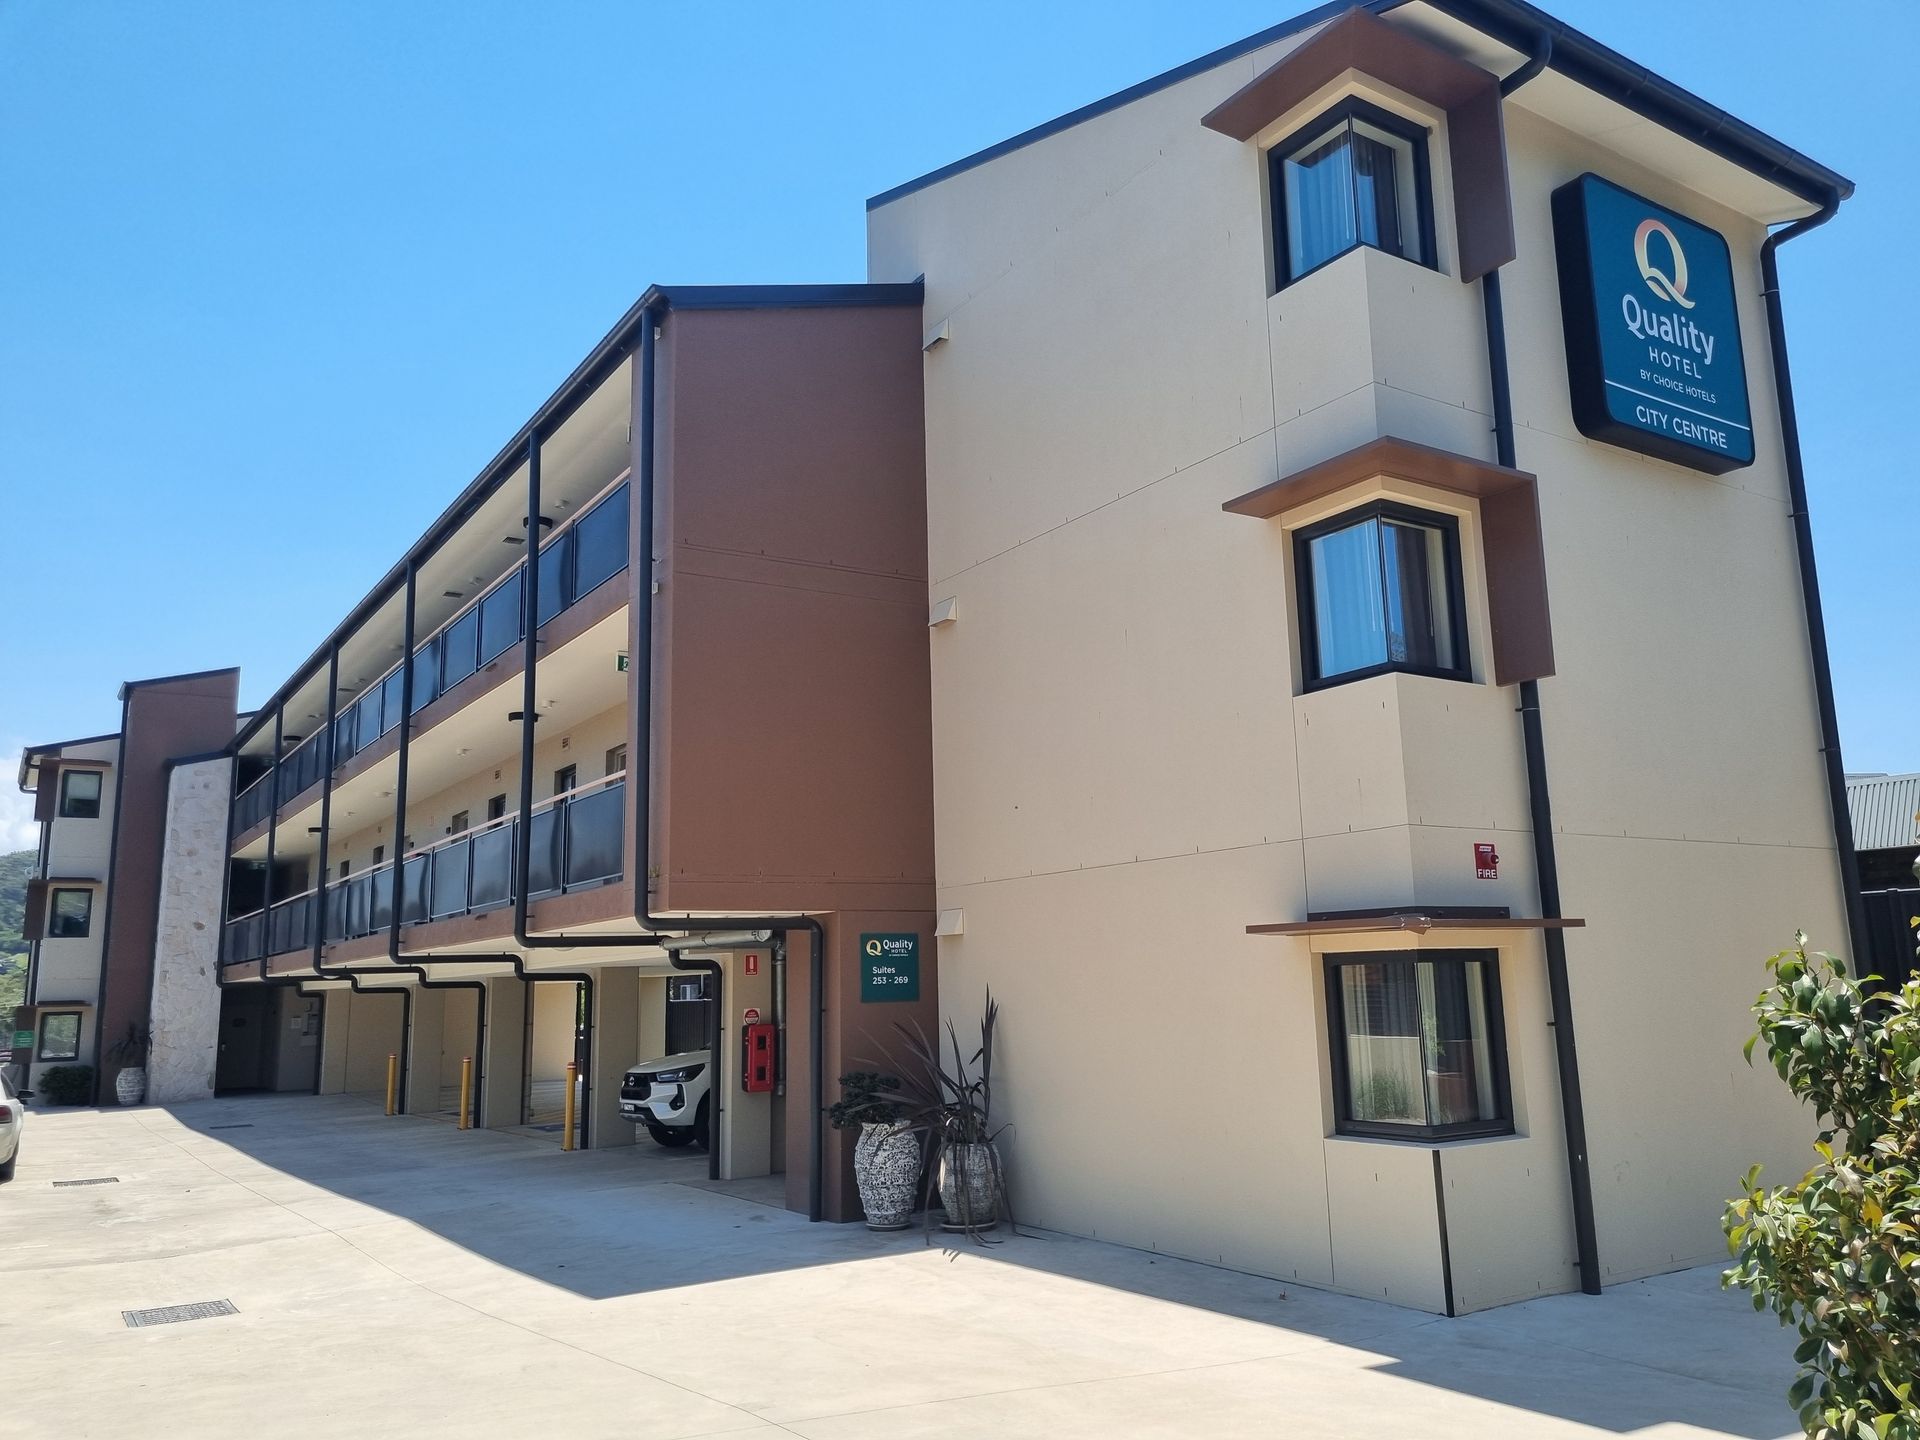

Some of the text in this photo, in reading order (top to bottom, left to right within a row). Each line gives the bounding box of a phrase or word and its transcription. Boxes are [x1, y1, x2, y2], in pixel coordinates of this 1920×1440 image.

[1634, 219, 1696, 309] Q
[1622, 294, 1714, 365] Quality
[1649, 346, 1702, 379] HOTEL
[1640, 369, 1717, 405] BY CHOICE HOTELS
[1636, 405, 1728, 449] CITY CENTRE
[1477, 868, 1497, 878] FIRE
[883, 939, 913, 950] Quality
[872, 966, 896, 974] Suites
[872, 976, 887, 985] 253
[894, 976, 909, 984] 269
